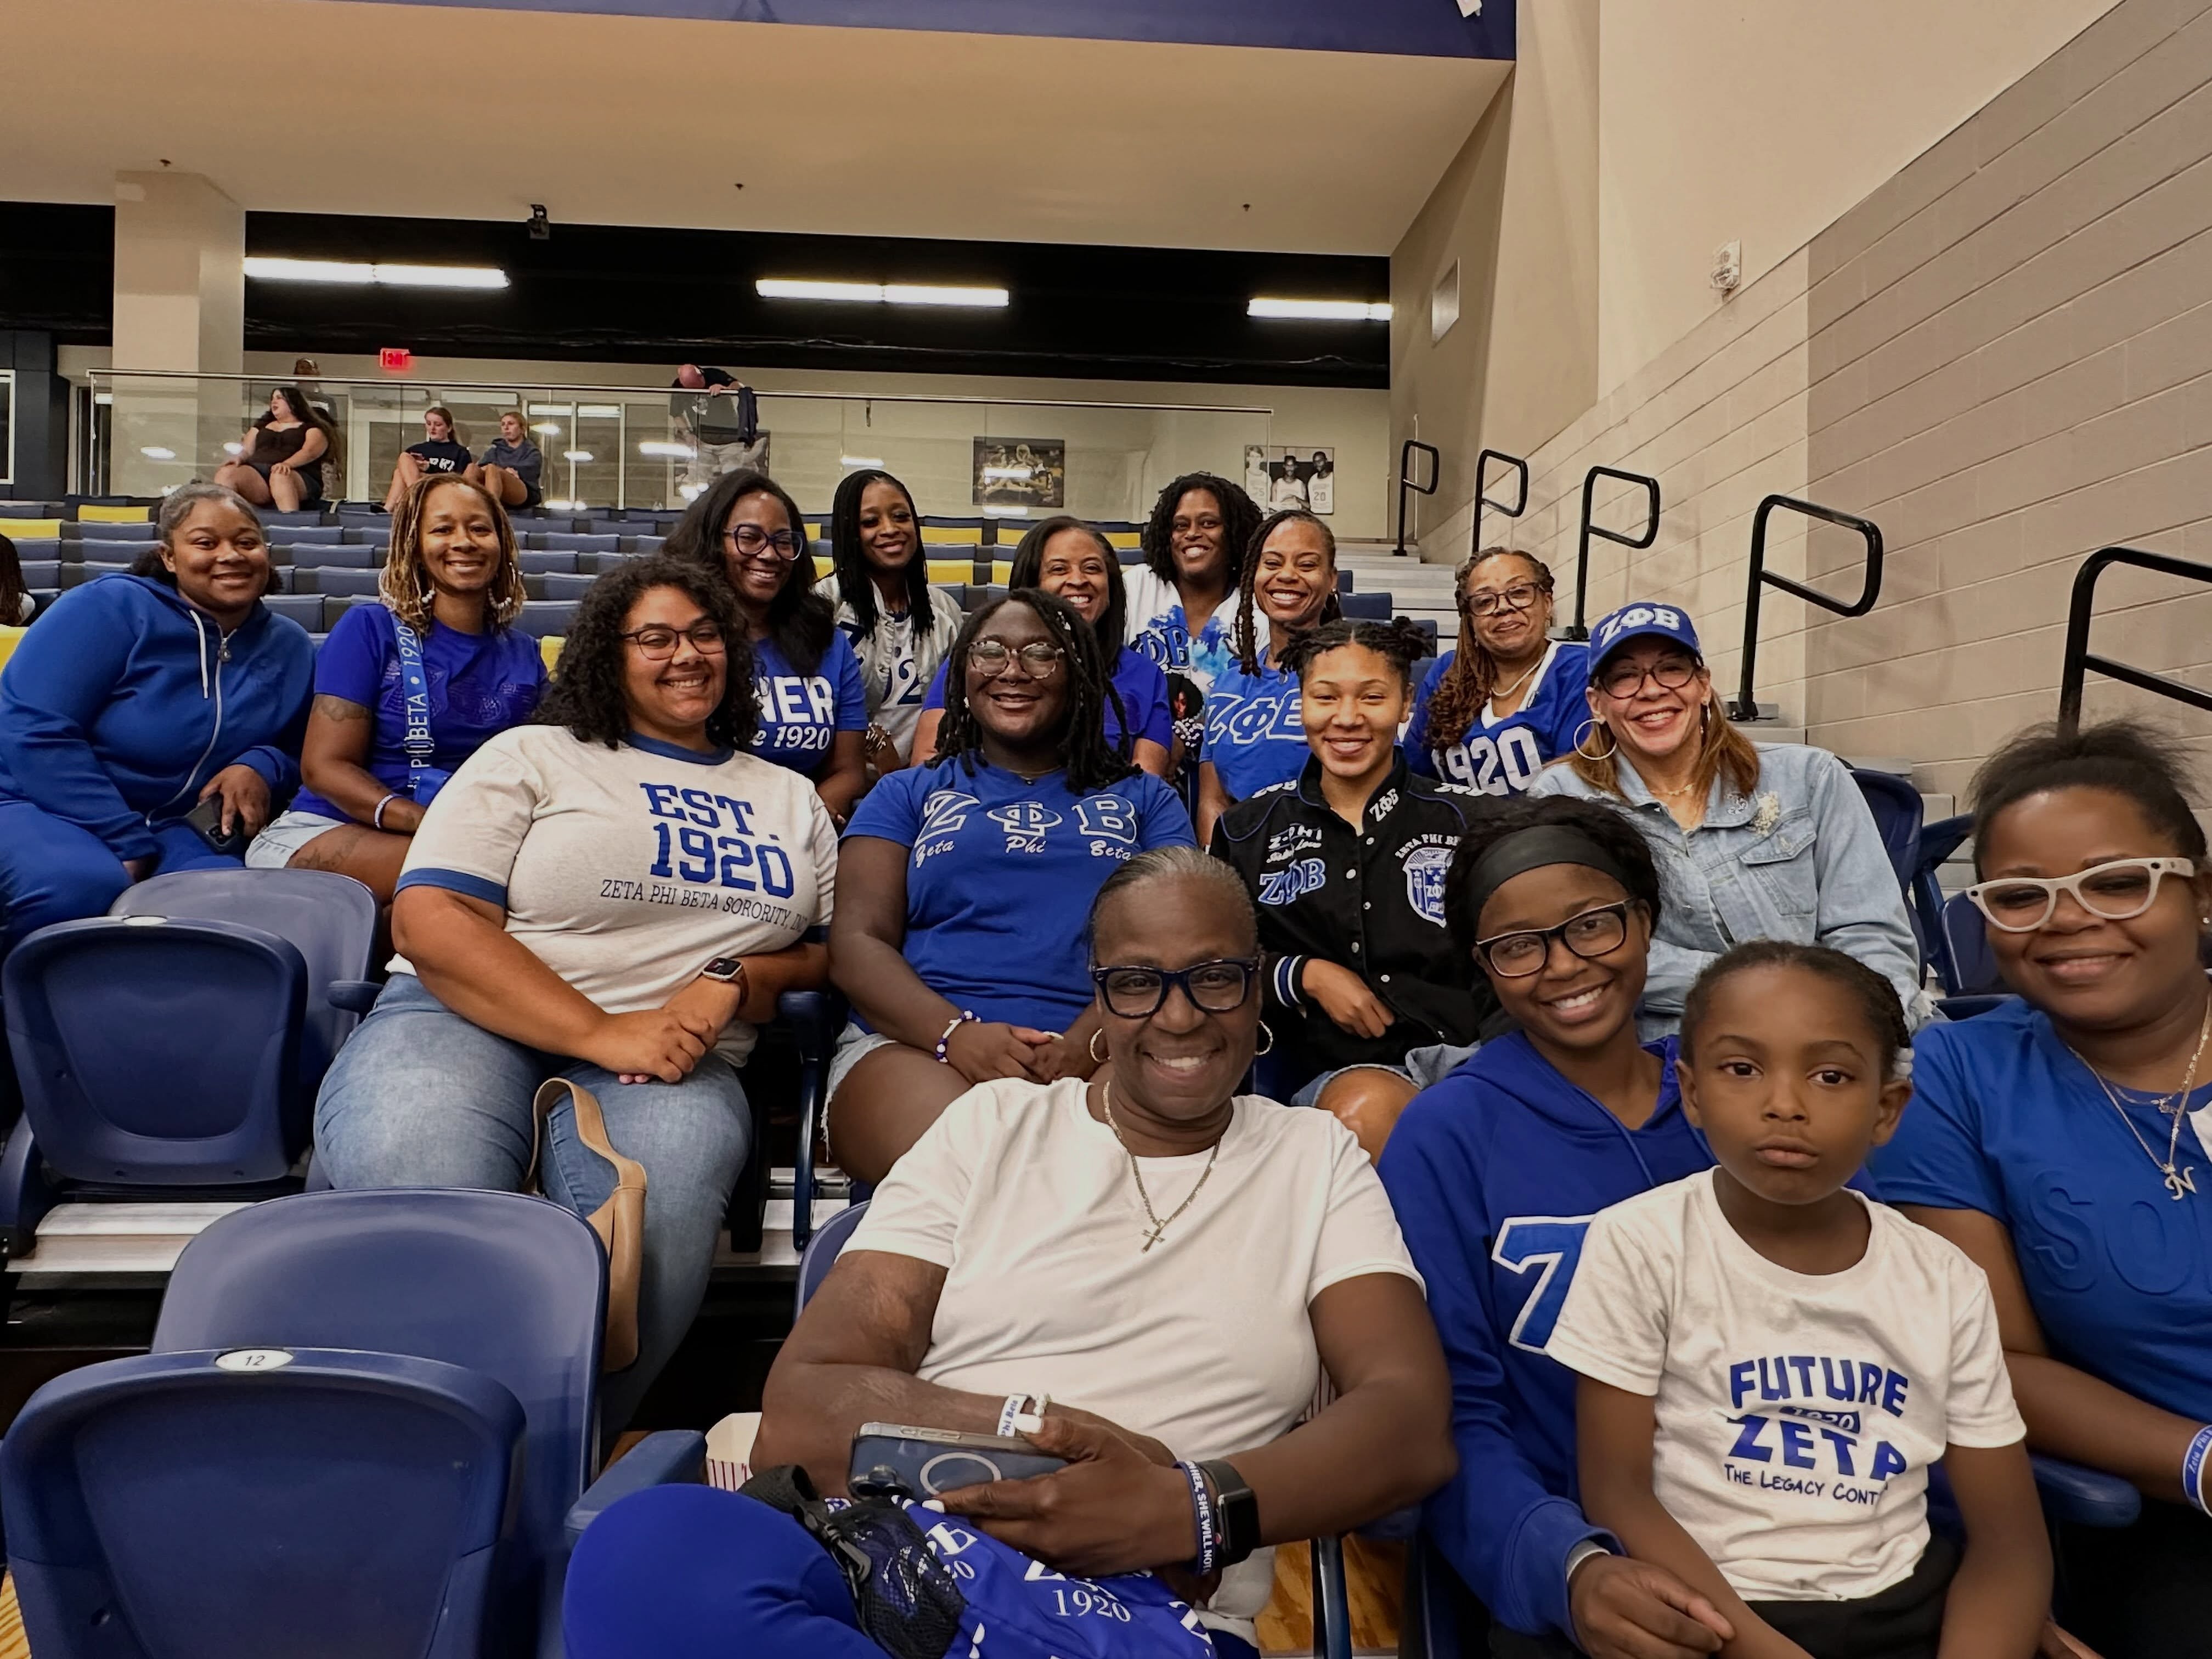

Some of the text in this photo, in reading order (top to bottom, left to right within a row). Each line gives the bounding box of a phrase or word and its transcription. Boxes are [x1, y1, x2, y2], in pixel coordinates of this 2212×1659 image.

[383, 350, 410, 366] EXIT
[397, 626, 421, 667] 1920
[1599, 608, 1680, 647] ZΦB
[407, 693, 430, 738] BETA
[774, 726, 830, 750] 1920
[639, 783, 780, 840] EST.
[1005, 835, 1046, 854] Phi
[1090, 840, 1132, 861] Beta
[1421, 834, 1443, 844] PHI
[650, 822, 794, 899] 1920
[601, 879, 644, 901] ZETA
[649, 884, 678, 905] PHI
[680, 890, 719, 910] BETA
[1258, 858, 1326, 905] ZΦB
[2030, 1169, 2212, 1296] SO
[245, 1355, 266, 1366] 12
[1730, 1356, 1909, 1418] FUTURE
[1052, 1589, 1132, 1622] 1920
